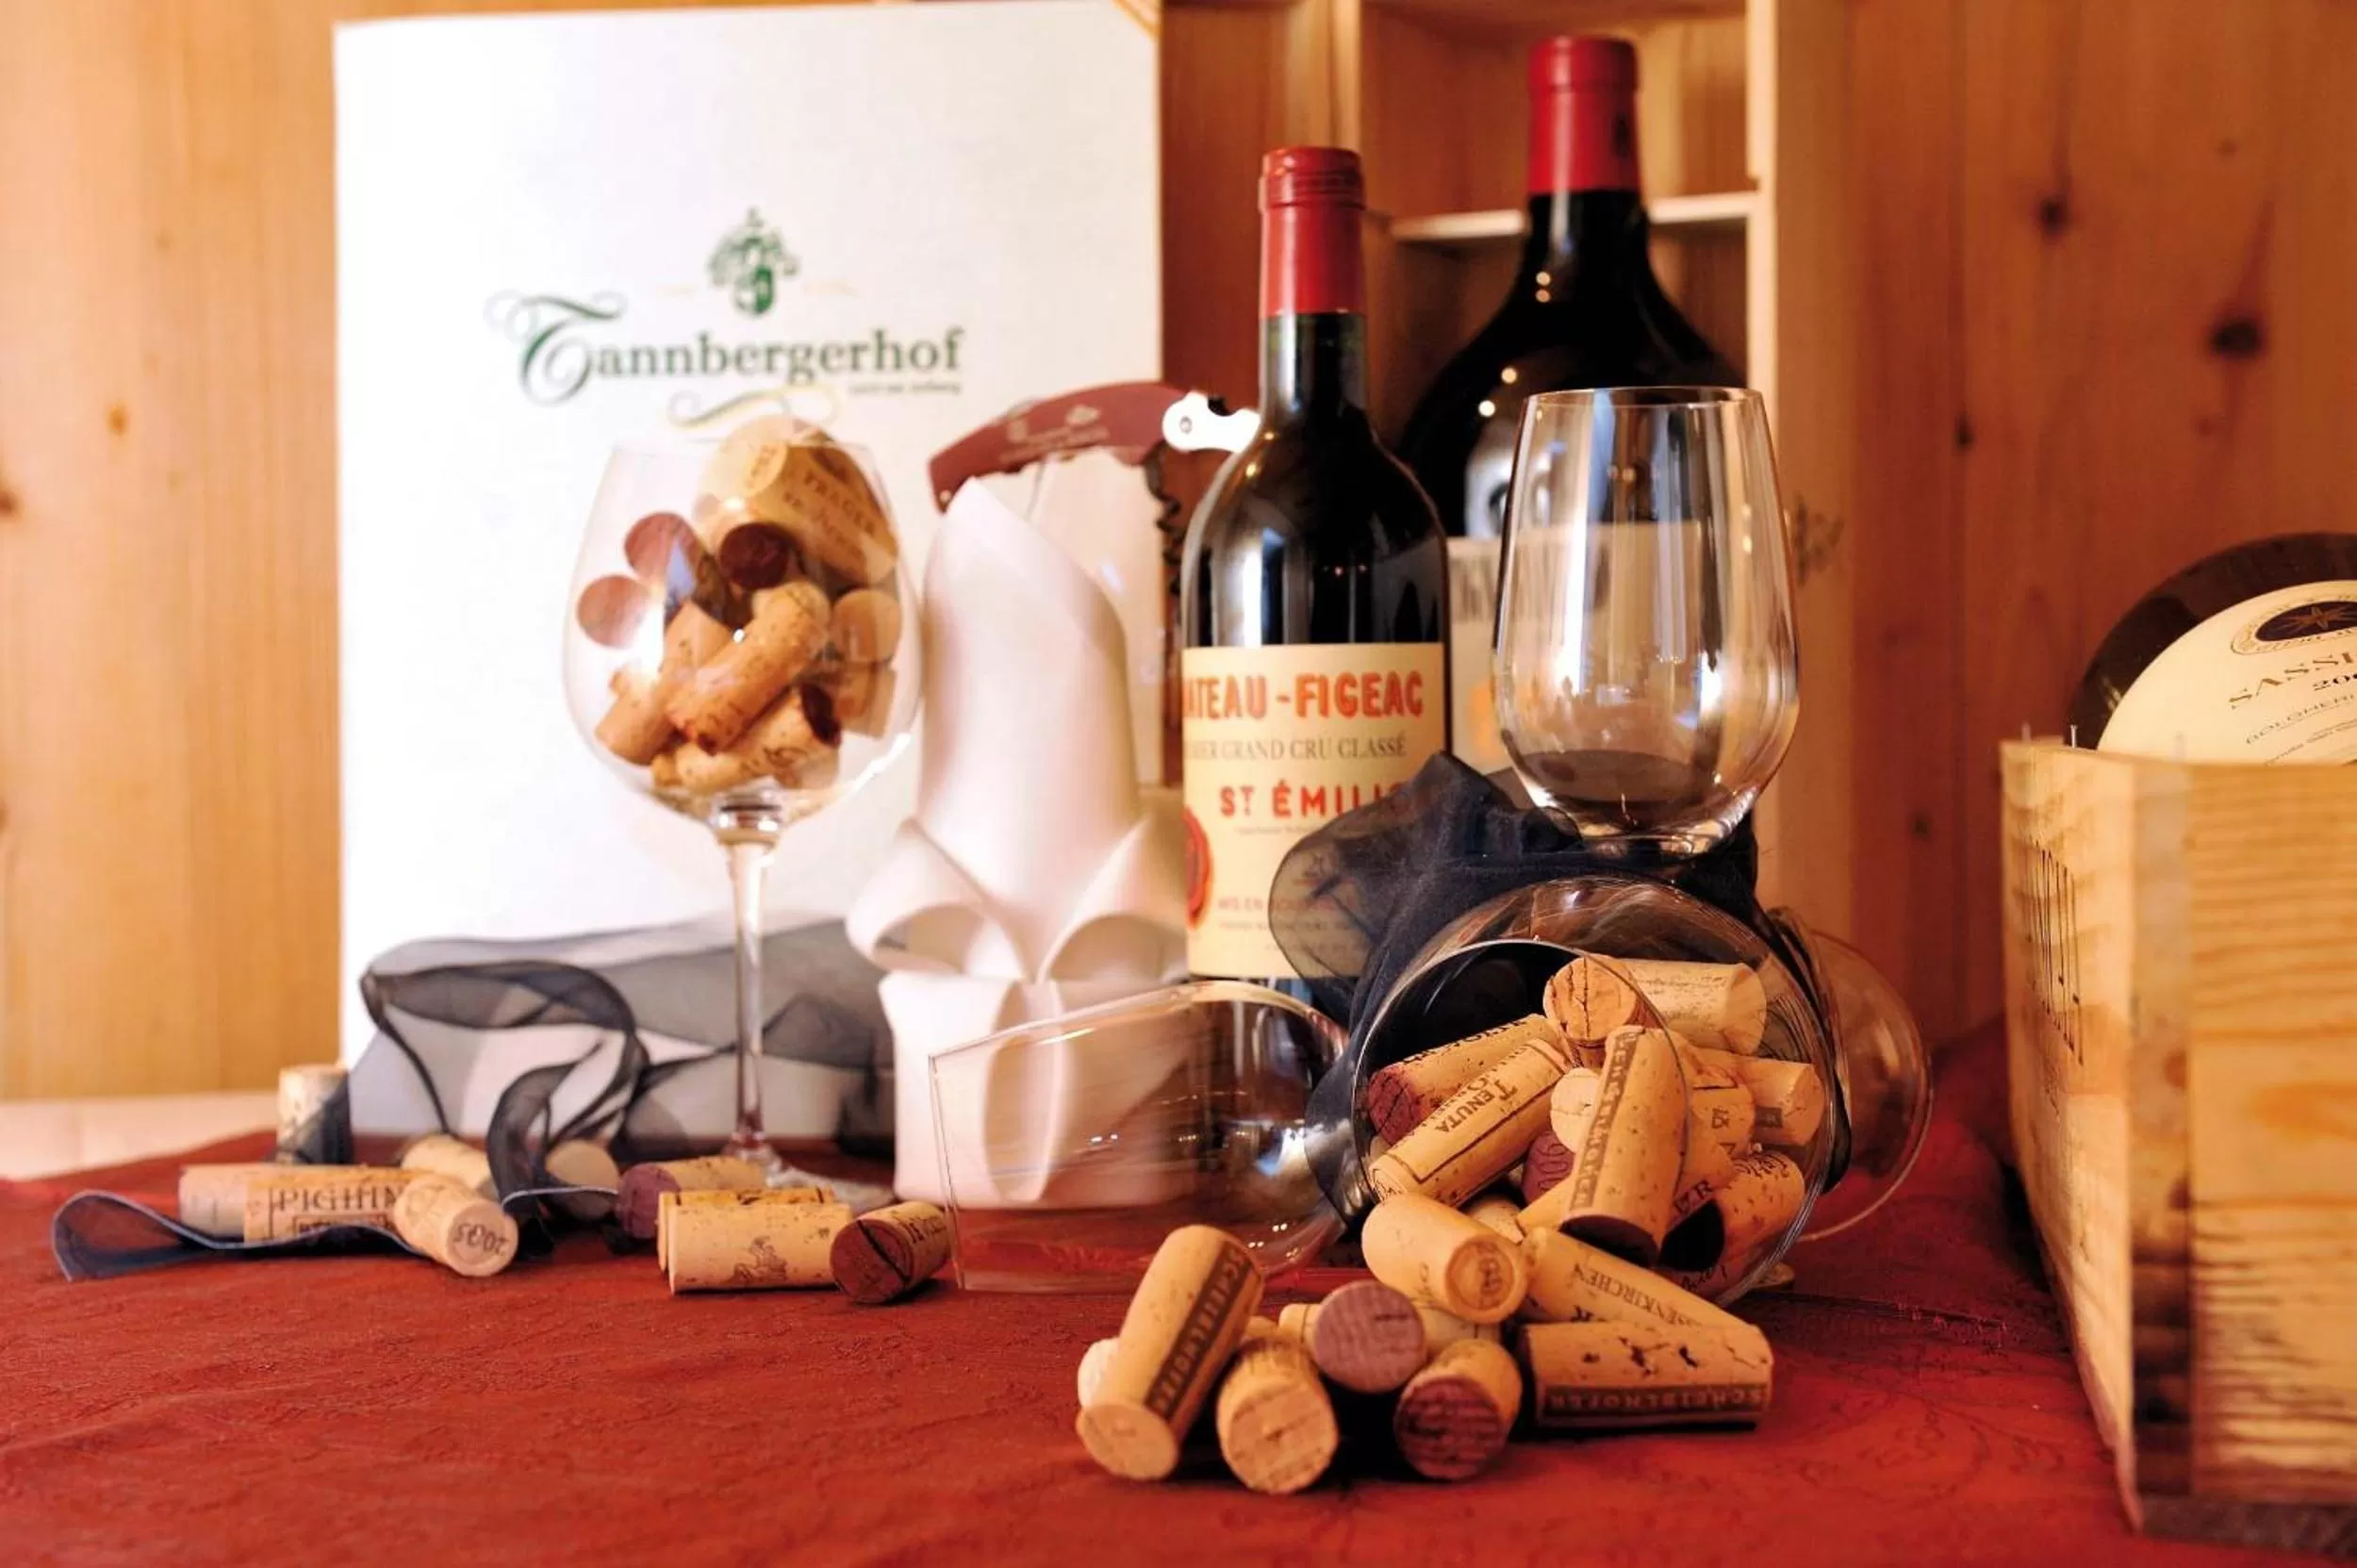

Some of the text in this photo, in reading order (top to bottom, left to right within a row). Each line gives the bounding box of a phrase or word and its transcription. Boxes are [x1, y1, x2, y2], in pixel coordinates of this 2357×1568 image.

[484, 290, 964, 406] Tannbergerhof
[1222, 738, 1285, 762] GRAND
[1289, 736, 1332, 760] CRU
[1434, 1079, 1519, 1135] TENUTA
